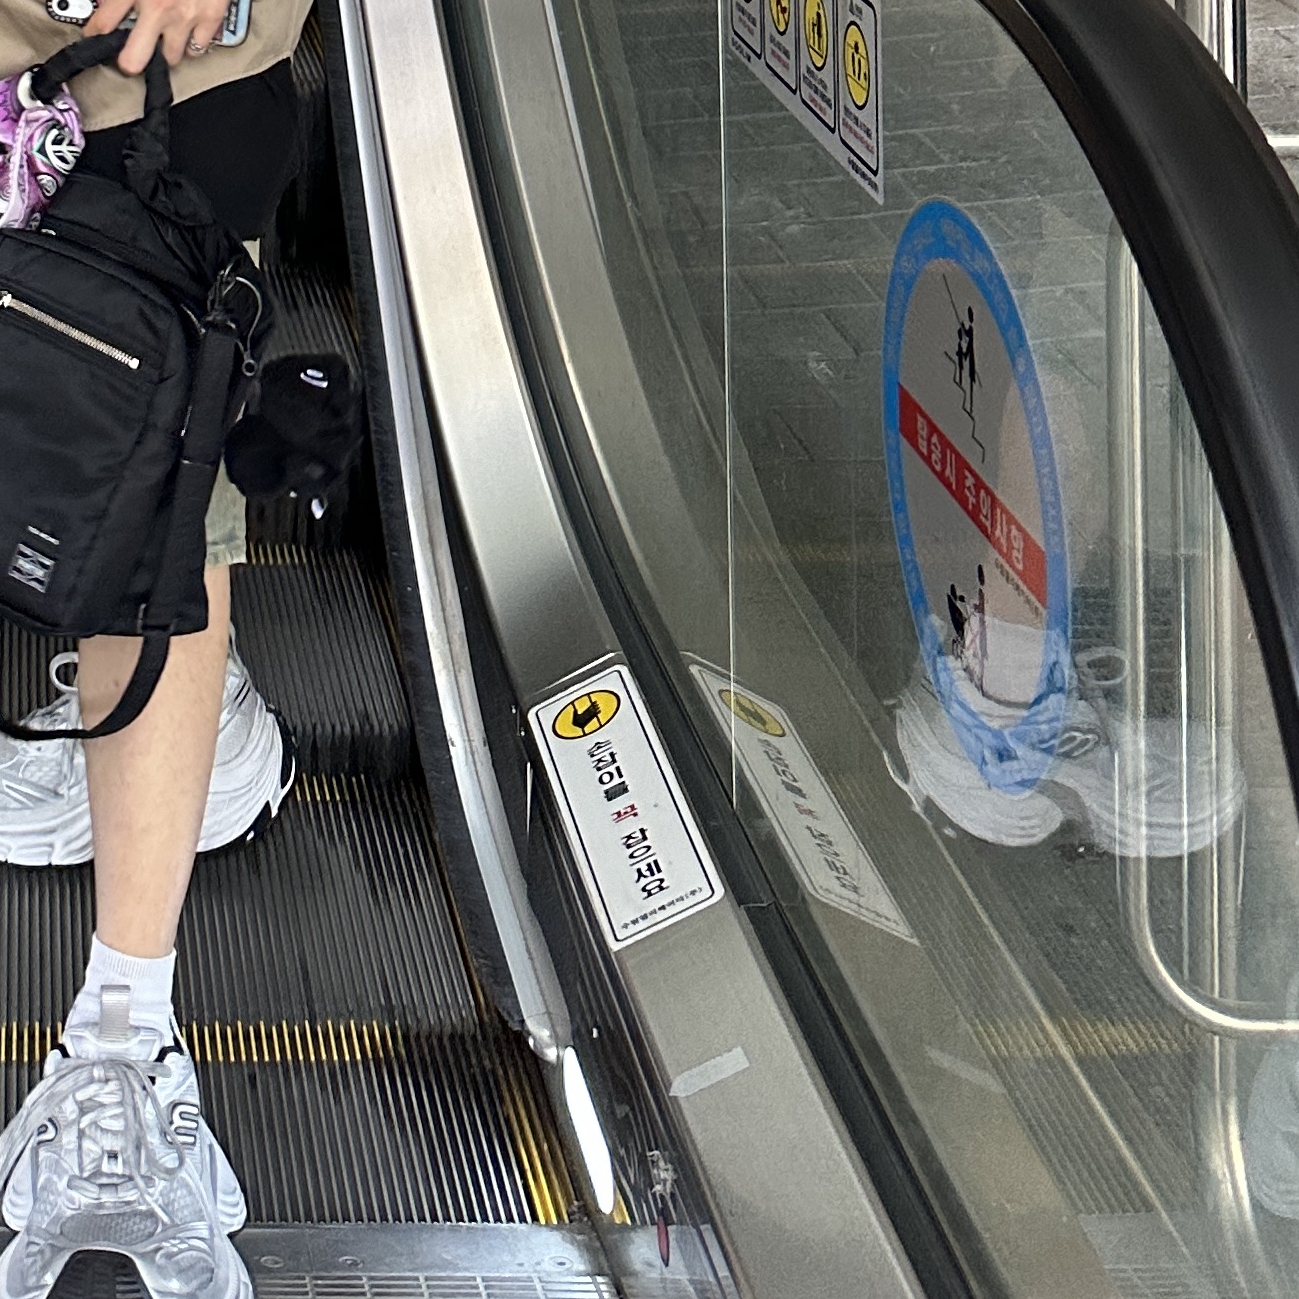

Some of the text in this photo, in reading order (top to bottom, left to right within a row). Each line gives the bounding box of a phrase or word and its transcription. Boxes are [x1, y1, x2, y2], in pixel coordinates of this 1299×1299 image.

[587, 739, 670, 900] 손잡이를 꼭 잡으세요
